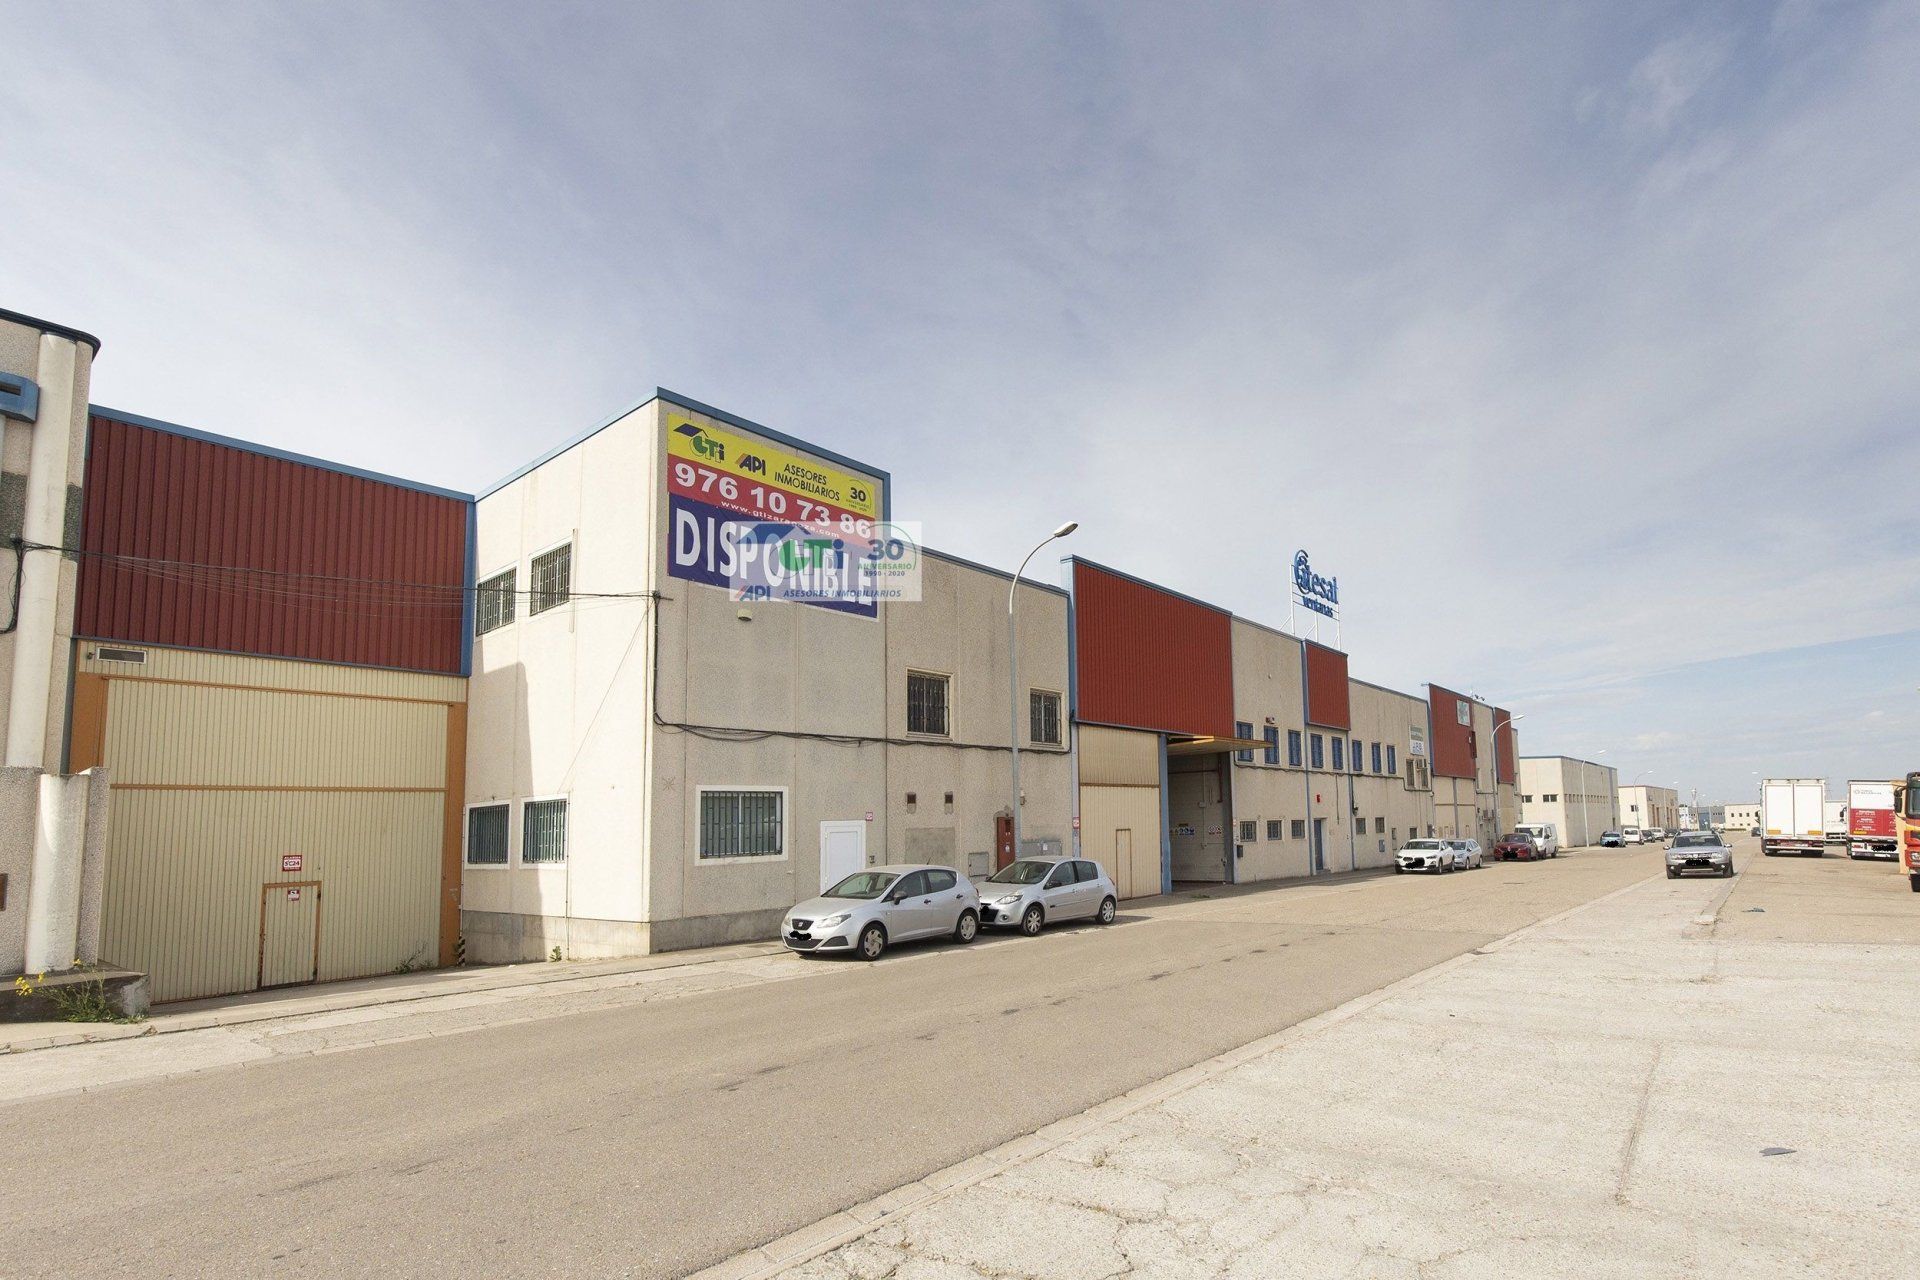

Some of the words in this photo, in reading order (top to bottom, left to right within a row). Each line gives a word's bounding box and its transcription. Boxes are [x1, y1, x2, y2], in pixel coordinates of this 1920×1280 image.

[738, 454, 766, 476] API
[783, 463, 827, 486] ASESORES
[774, 471, 840, 502] INMOBILIARIOS
[850, 487, 867, 502] 30
[674, 462, 739, 501] 976
[750, 486, 787, 514] 10
[796, 499, 831, 527] 73
[839, 513, 872, 539] 86
[675, 507, 872, 607] DISPONIBLE
